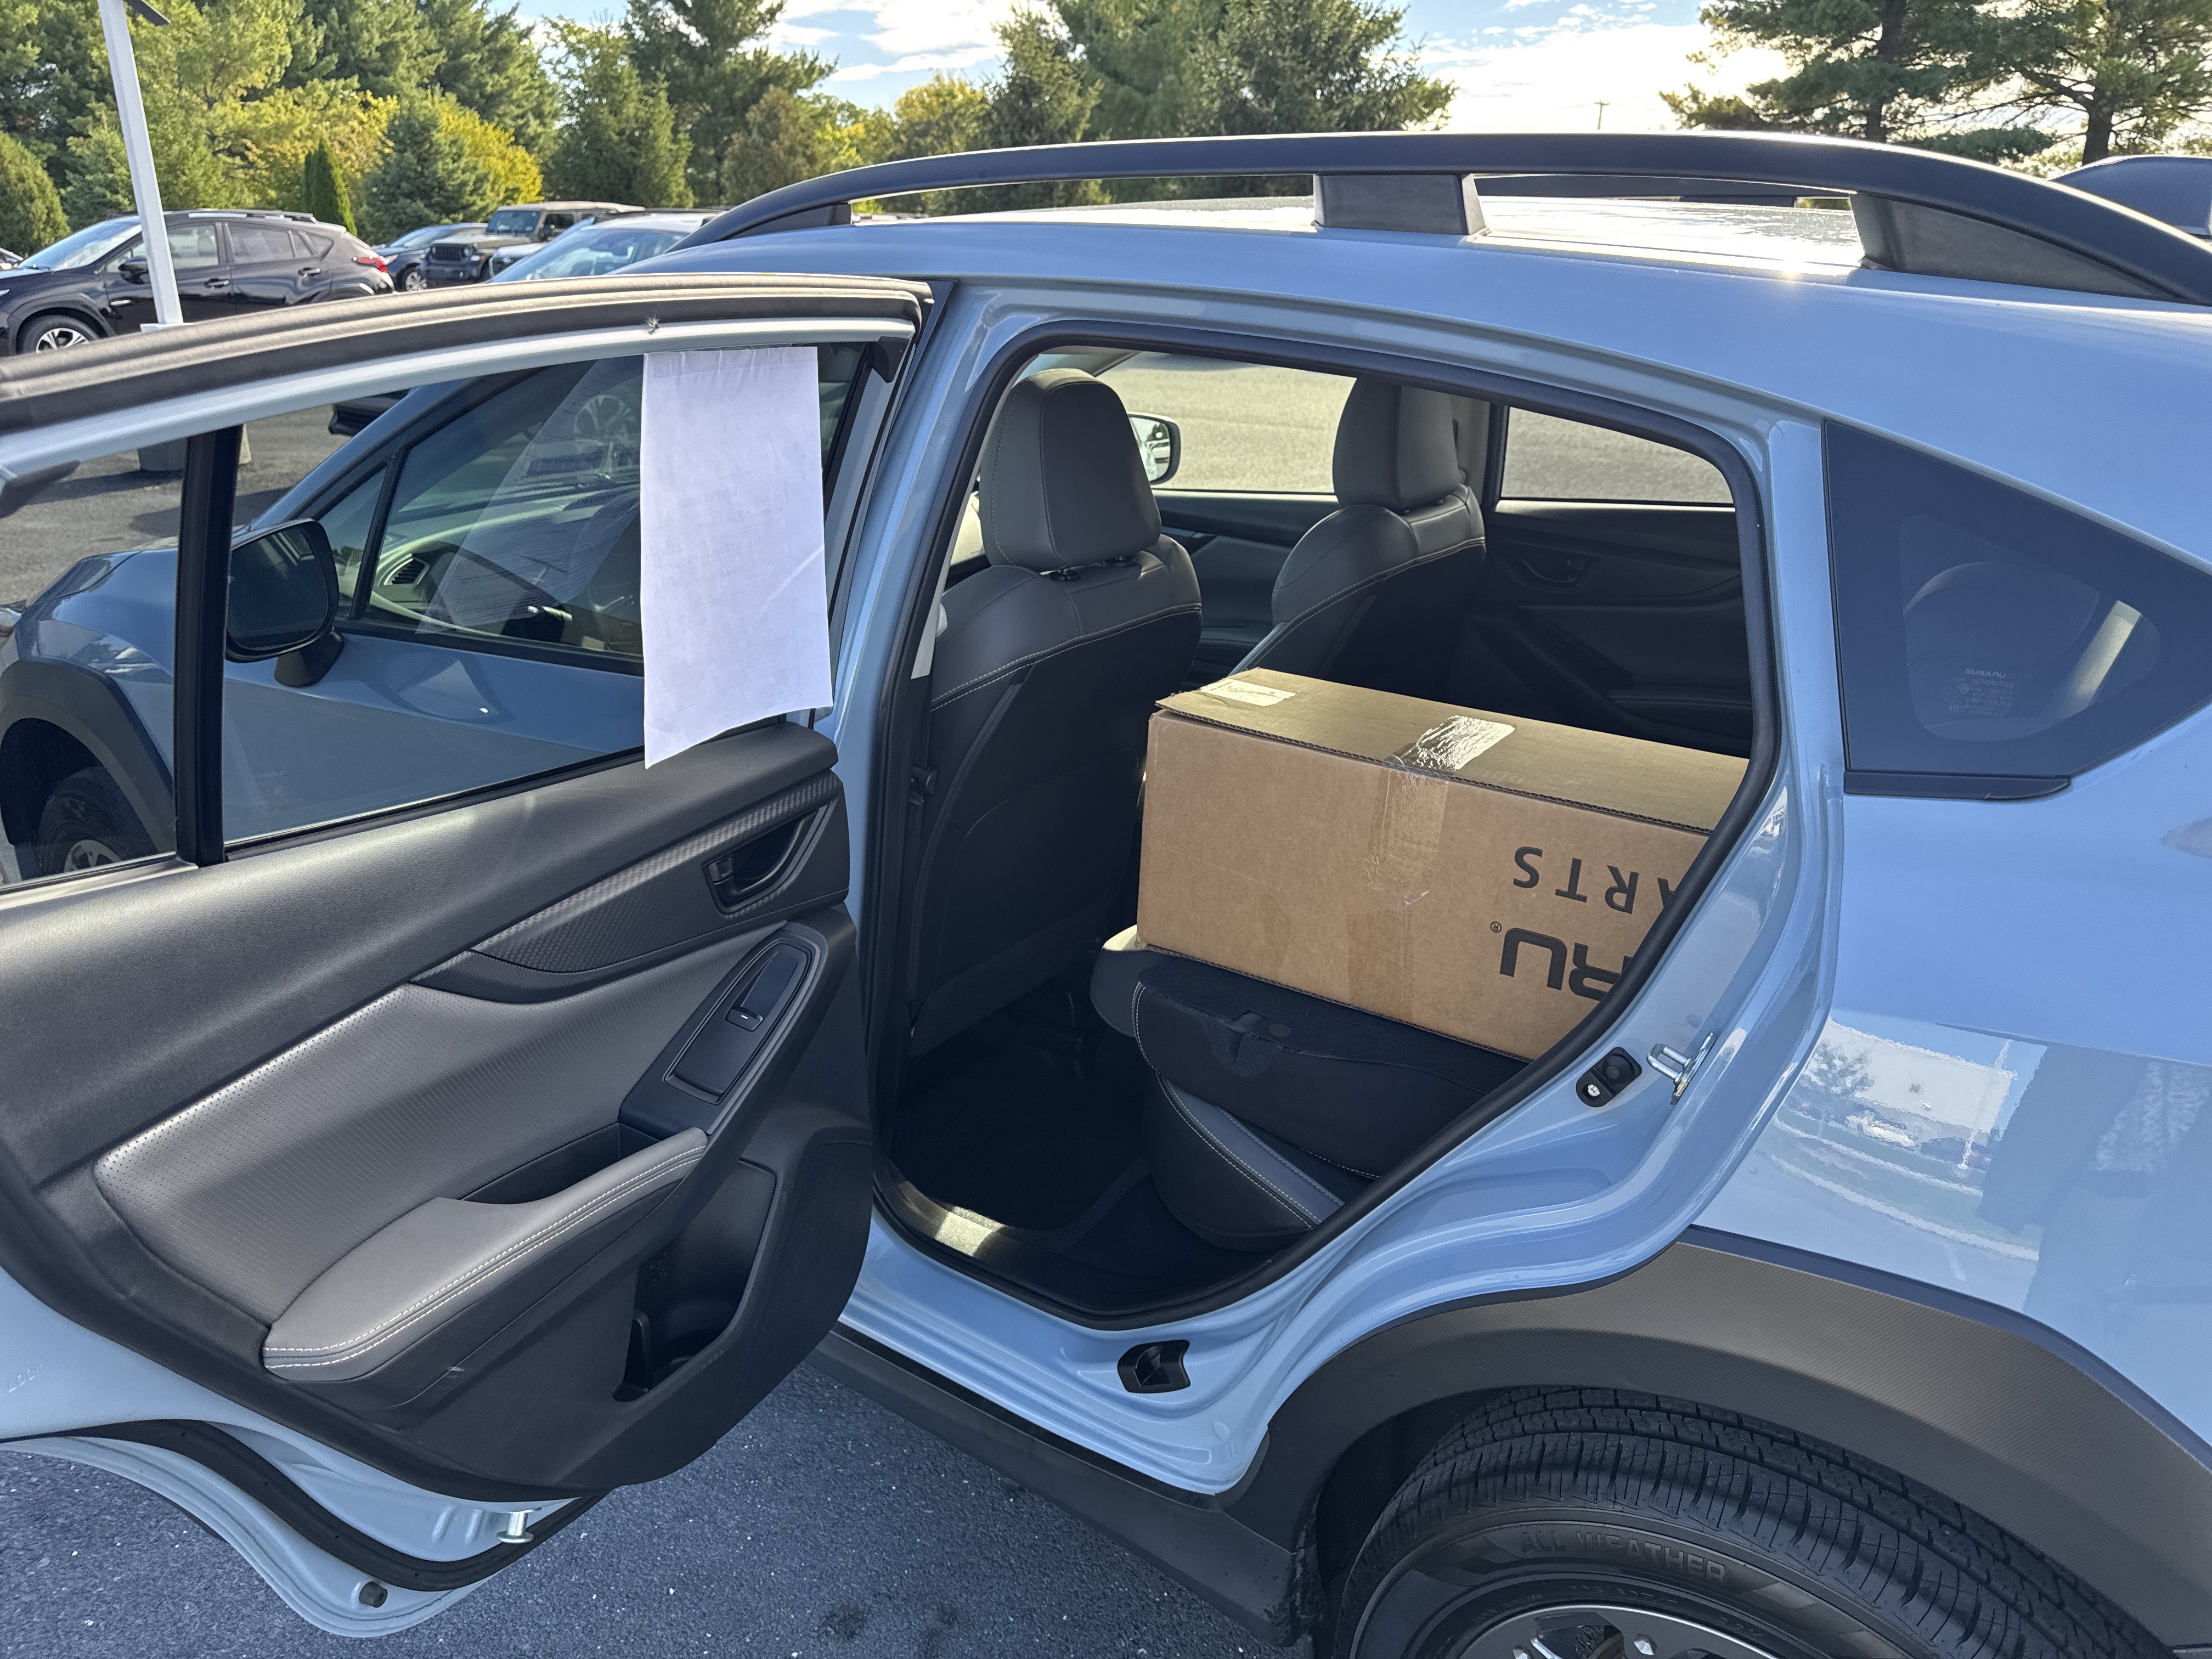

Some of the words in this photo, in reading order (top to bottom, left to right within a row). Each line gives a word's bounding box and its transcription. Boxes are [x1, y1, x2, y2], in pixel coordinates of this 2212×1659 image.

[1965, 668, 2006, 678] SUBARU
[1521, 1530, 1568, 1553] ALL
[1575, 1530, 1726, 1581] WEATHER
